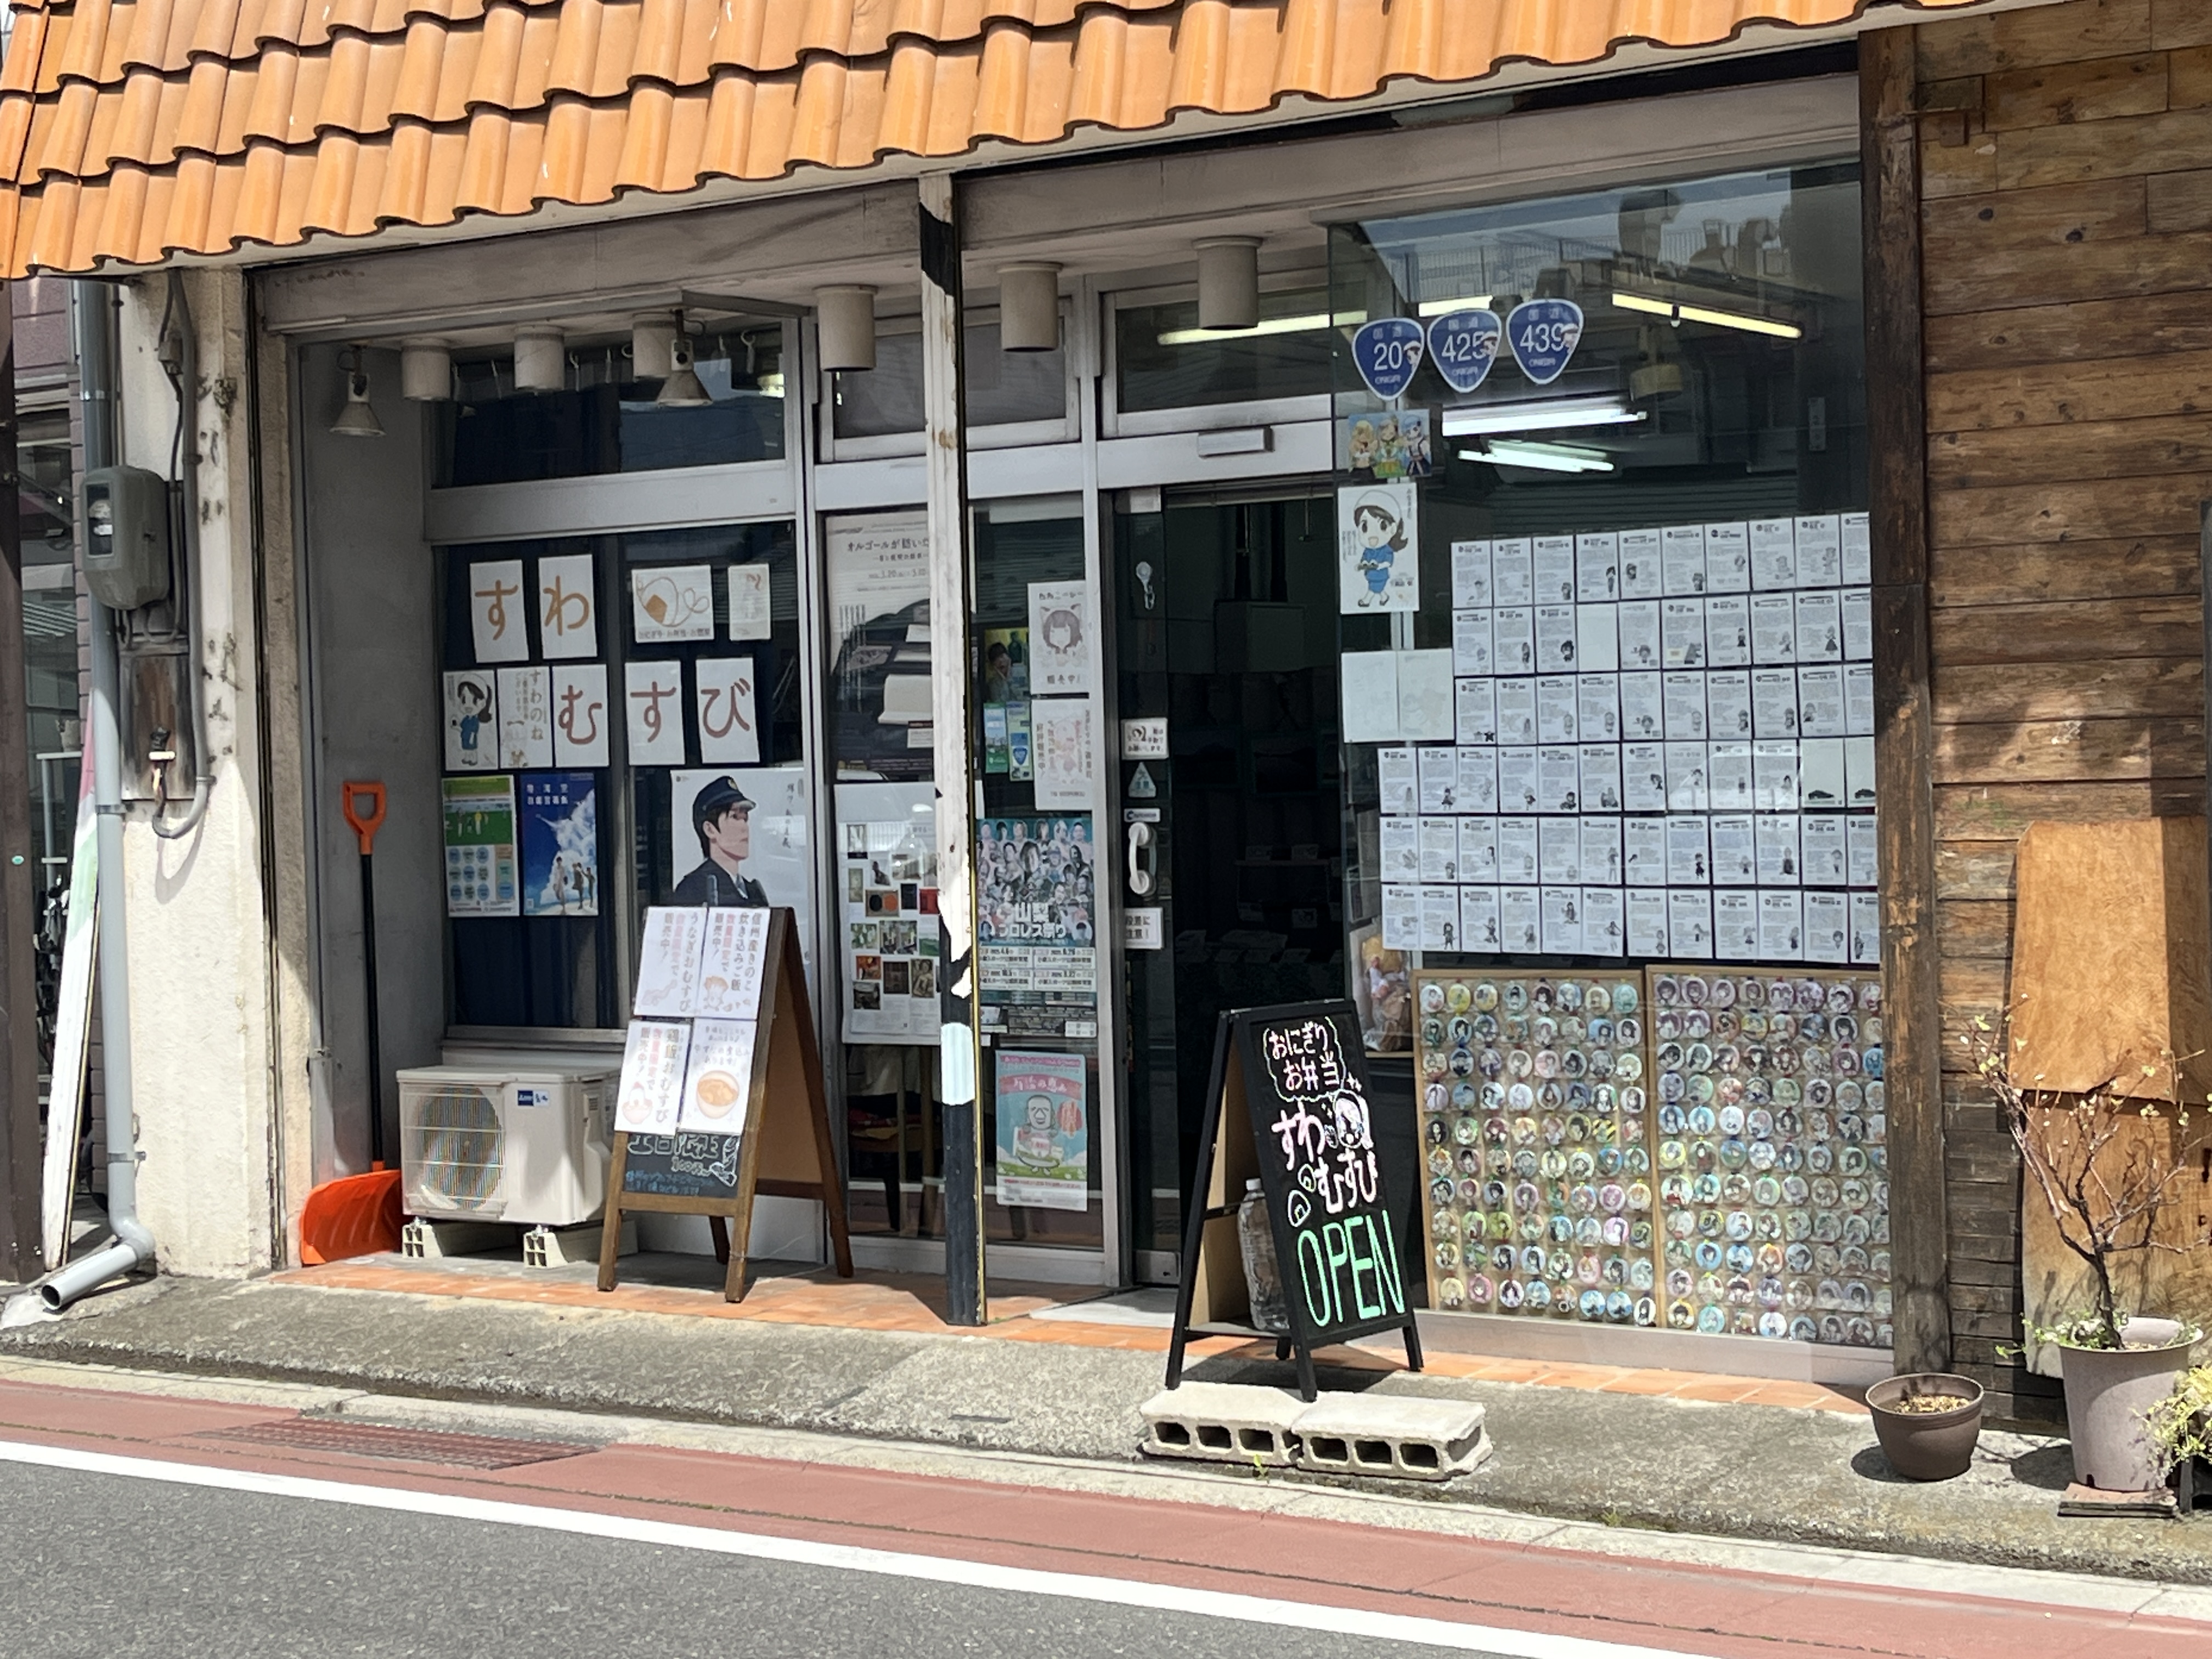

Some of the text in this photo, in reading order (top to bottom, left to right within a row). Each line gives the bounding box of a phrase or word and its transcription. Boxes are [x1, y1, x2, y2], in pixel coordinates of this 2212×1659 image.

[1374, 341, 1403, 370] 20
[1442, 332, 1483, 362] 425
[1520, 324, 1565, 353] 439
[998, 923, 1066, 939] プロレス祭り
[1014, 902, 1049, 923] 山梨
[731, 912, 750, 992] 炊き込みご飯
[1268, 1021, 1329, 1059] おにぎり
[1284, 1051, 1341, 1091] お弁当
[1271, 1101, 1325, 1170] すわ
[1315, 1149, 1378, 1214] むすび
[1297, 1209, 1406, 1327] OPEN
